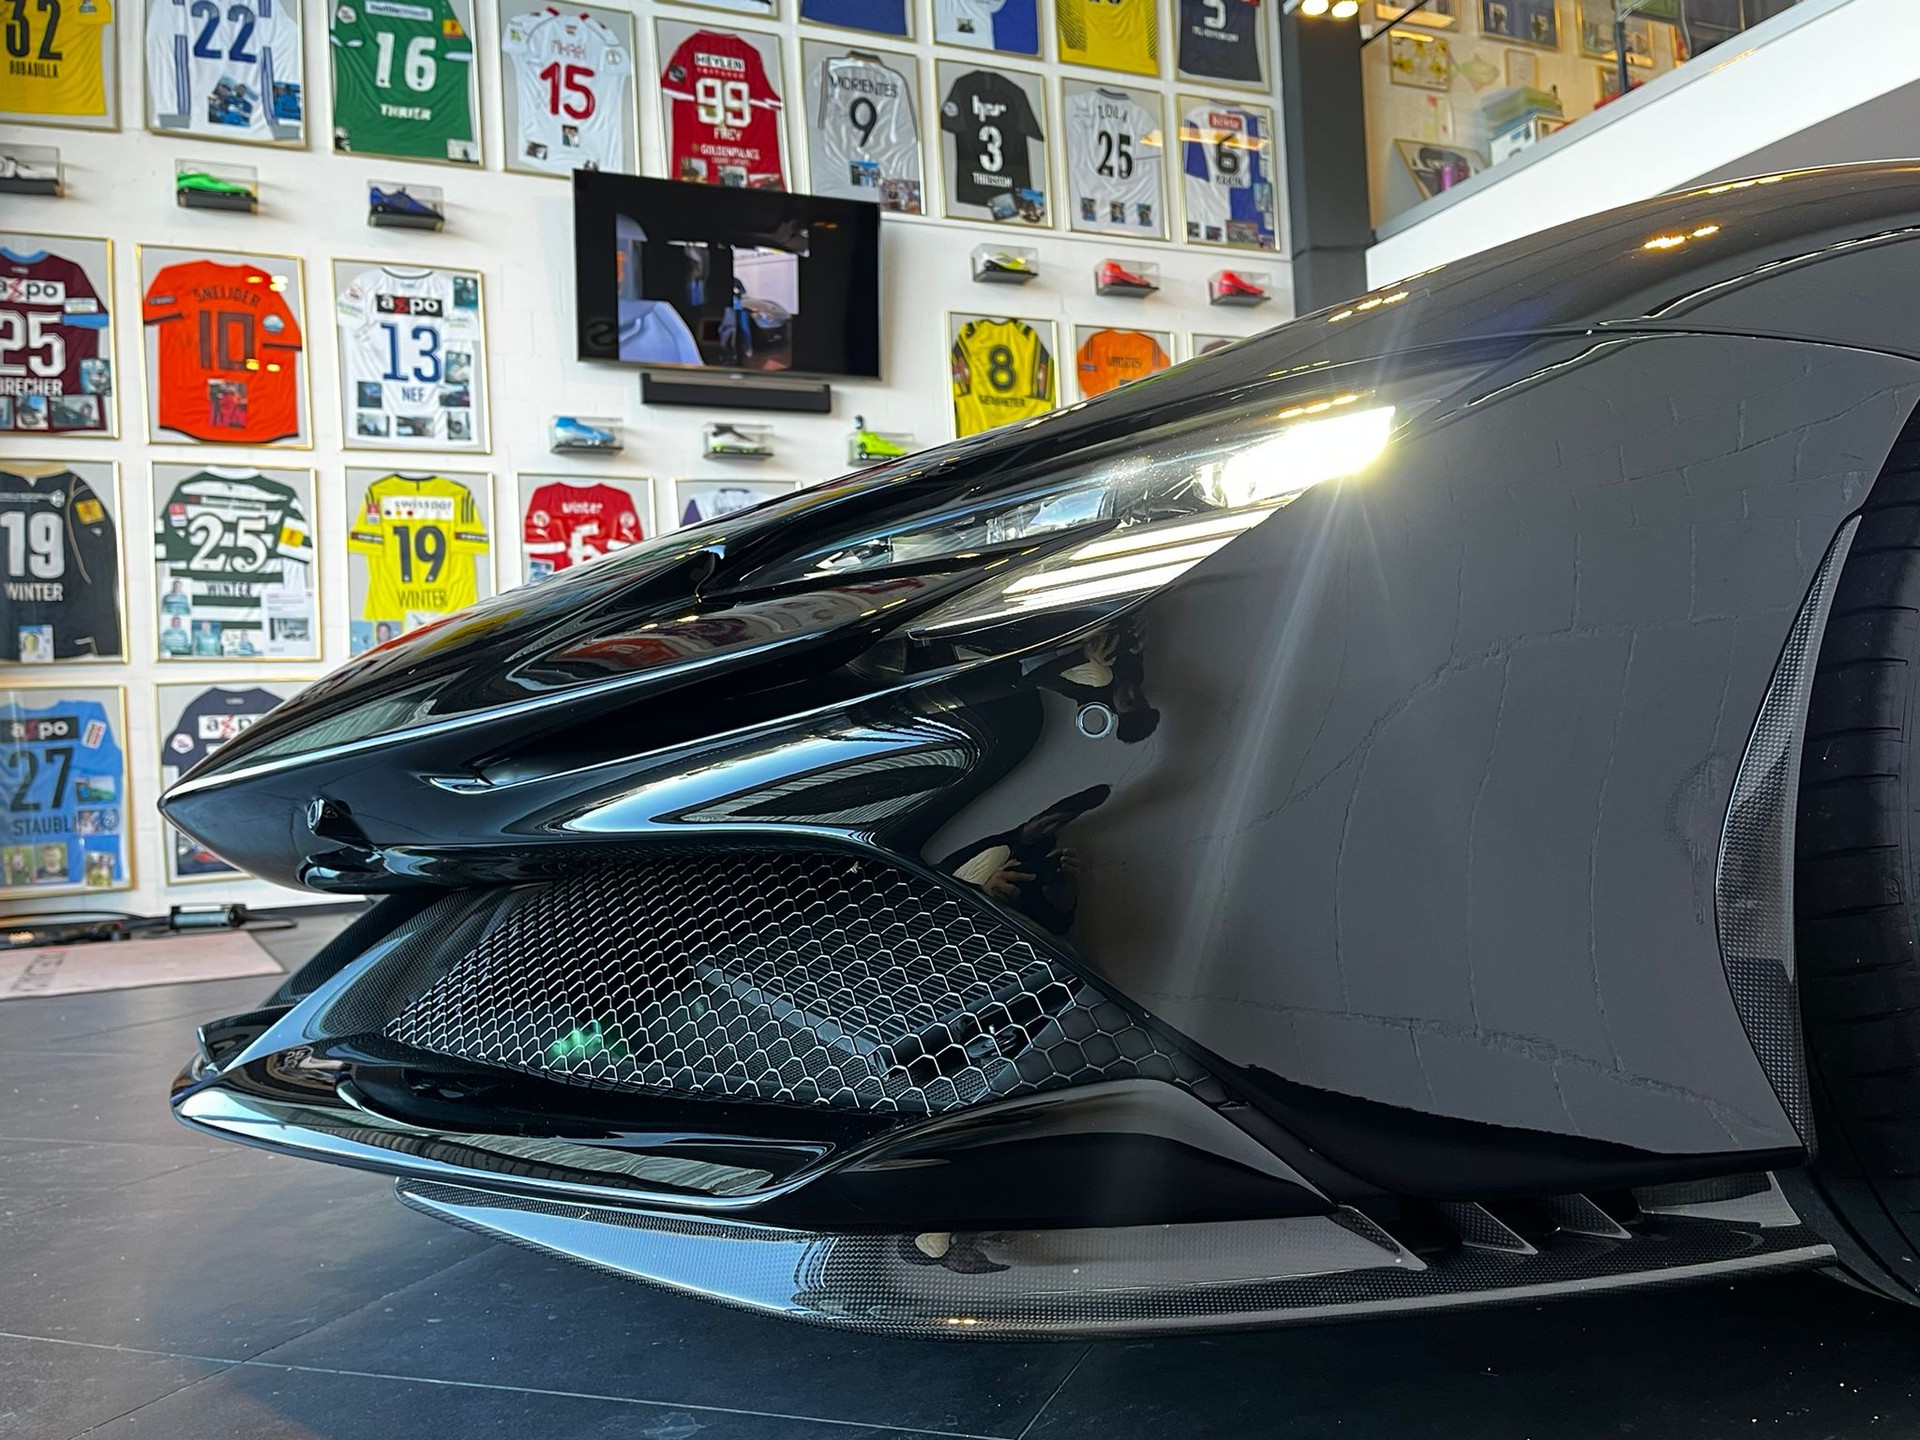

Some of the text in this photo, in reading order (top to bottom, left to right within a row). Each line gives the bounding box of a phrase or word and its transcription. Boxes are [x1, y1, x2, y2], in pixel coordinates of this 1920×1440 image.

[4, 0, 62, 60] 32
[191, 0, 257, 63] 22
[374, 31, 438, 92] 16
[540, 61, 595, 119] 15
[696, 78, 751, 127] 99
[850, 97, 877, 147] 9
[979, 126, 1003, 171] 3
[1097, 130, 1133, 179] 25
[1215, 133, 1239, 174] 6
[0, 309, 66, 377] 25
[198, 309, 256, 372] 10
[380, 322, 442, 383] 13
[988, 344, 1016, 394] 8
[0, 510, 66, 580] 19
[188, 512, 267, 574] 25
[392, 525, 447, 583] 19
[4, 582, 65, 602] WINTER
[396, 588, 448, 608] WINTER
[8, 747, 74, 813] 27
